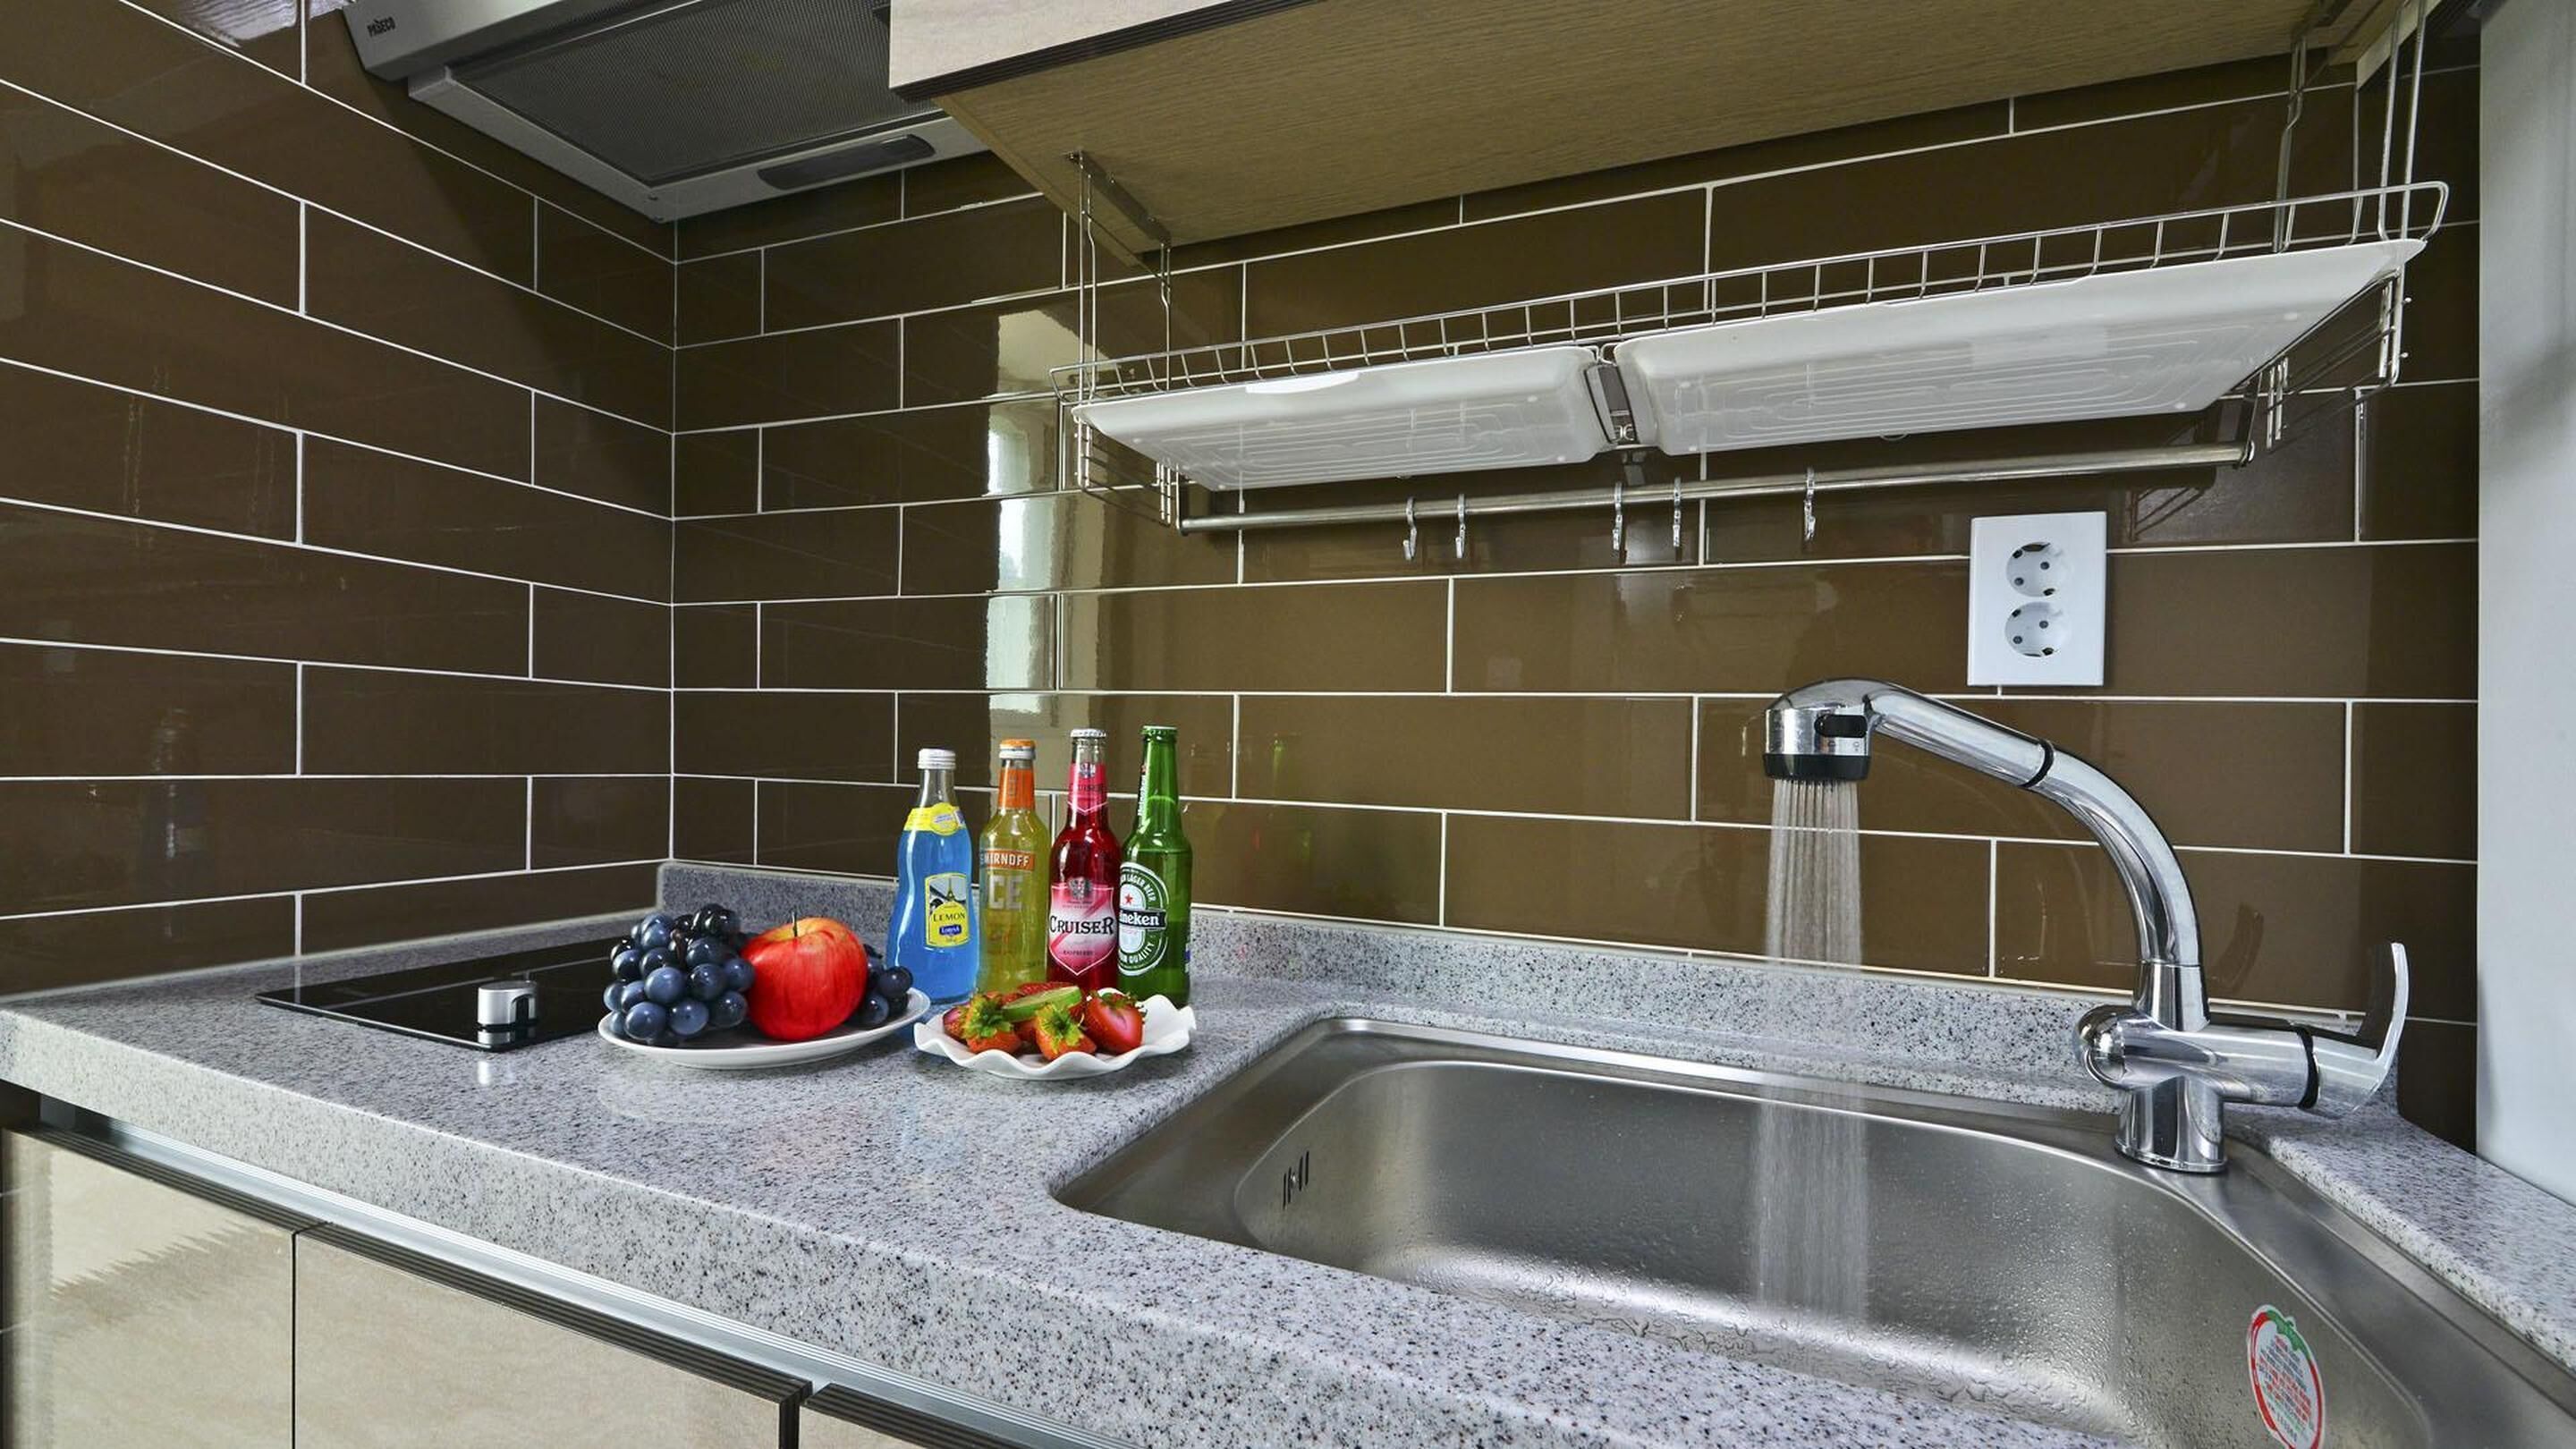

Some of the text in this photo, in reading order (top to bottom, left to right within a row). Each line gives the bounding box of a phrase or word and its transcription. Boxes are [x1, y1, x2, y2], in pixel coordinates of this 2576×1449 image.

[933, 912, 965, 922] LEMON
[1049, 915, 1114, 935] CRUISER
[1128, 942, 1154, 964] QUALITY
